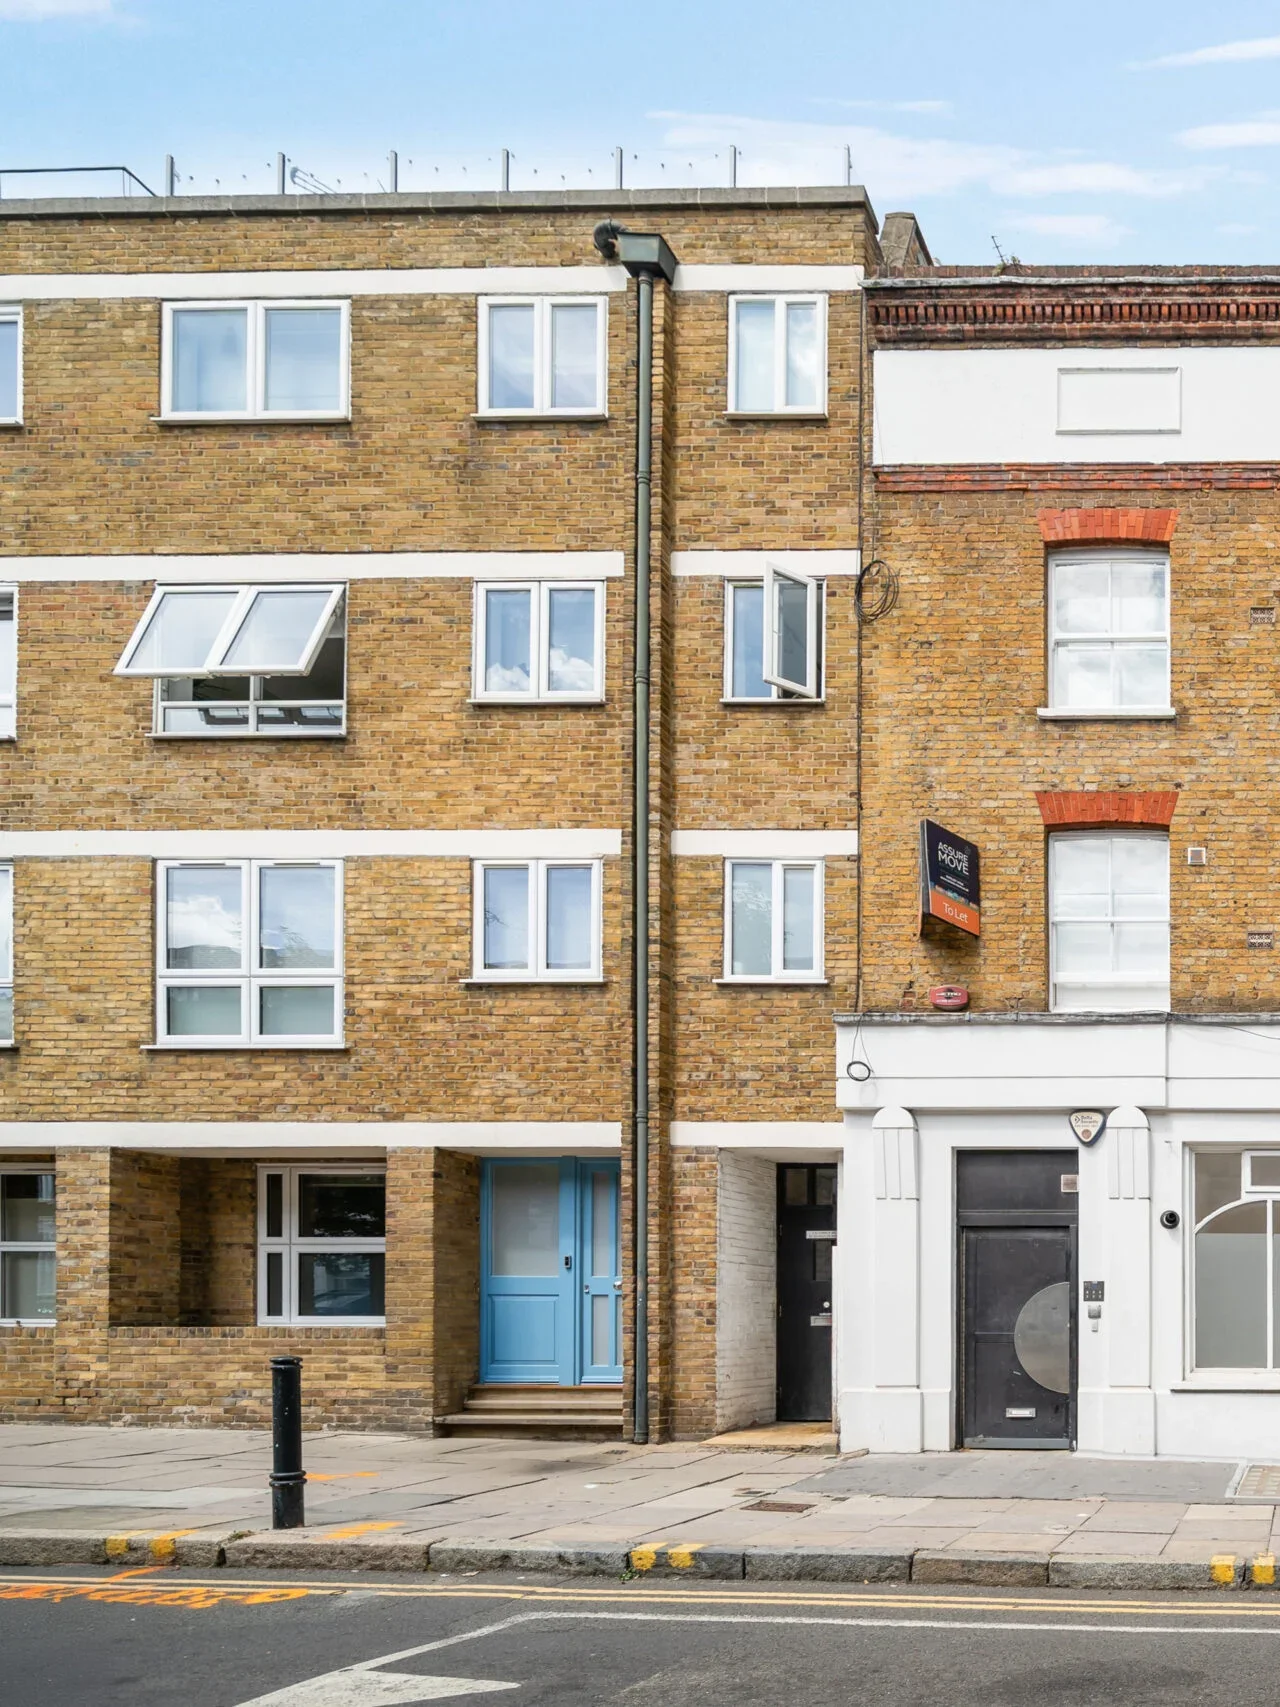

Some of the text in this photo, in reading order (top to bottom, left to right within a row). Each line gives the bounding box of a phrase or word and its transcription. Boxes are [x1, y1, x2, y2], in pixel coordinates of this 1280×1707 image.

[938, 841, 969, 864] ASSURE
[938, 850, 969, 875] MOVE
[943, 902, 968, 923] To Let
